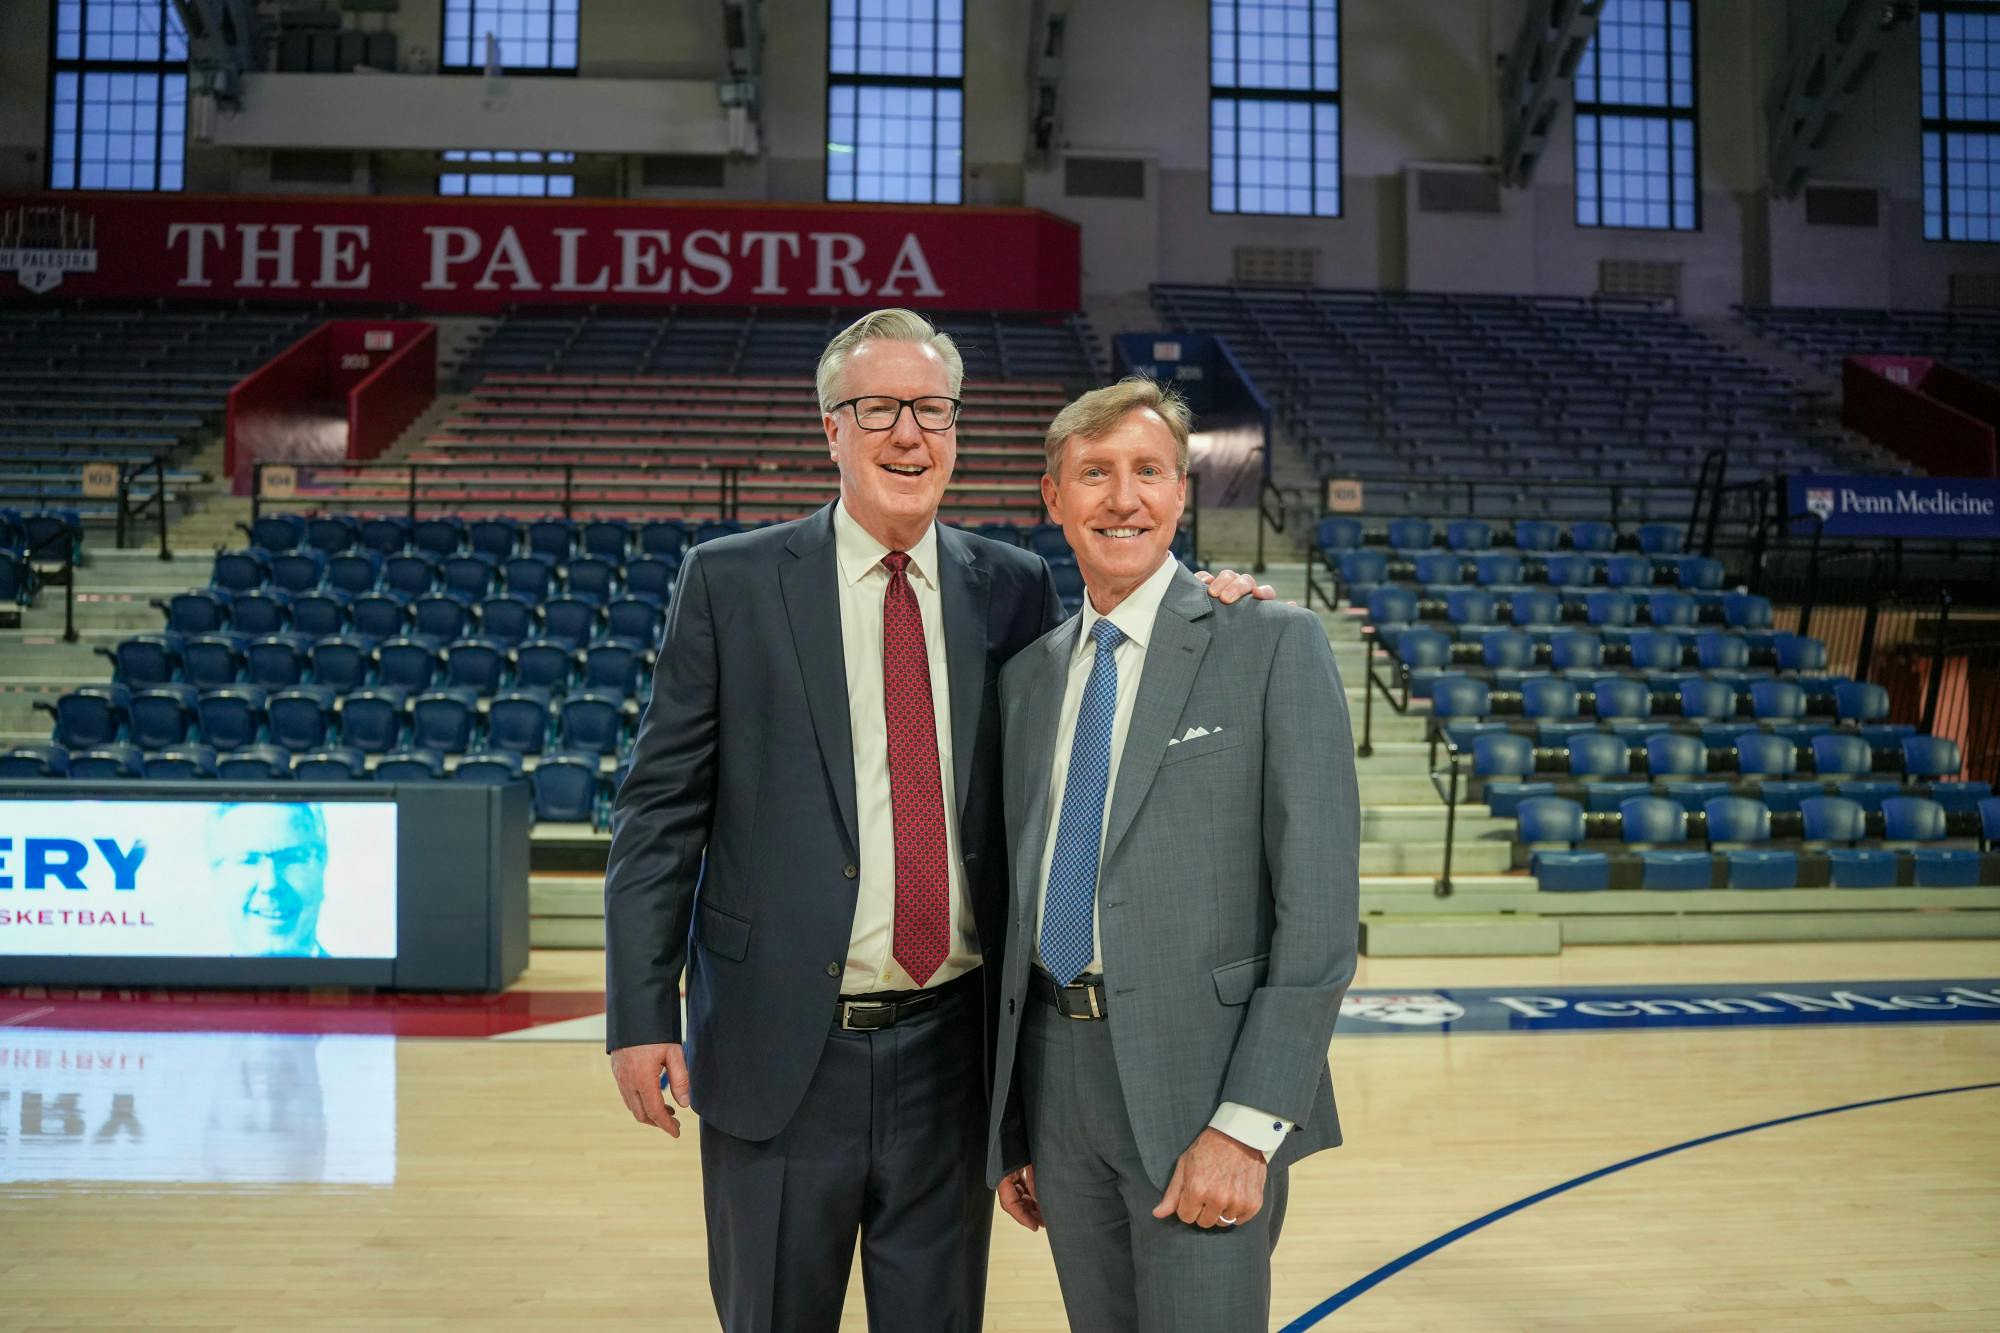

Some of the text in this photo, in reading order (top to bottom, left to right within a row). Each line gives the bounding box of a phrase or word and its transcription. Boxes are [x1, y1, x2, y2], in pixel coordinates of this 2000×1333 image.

[22, 253, 89, 268] PALESTRA
[166, 223, 945, 297] THE PALESTRA
[1840, 488, 1995, 515] Penn Medicine
[0, 838, 147, 890] RY
[1489, 996, 1787, 1018] Penn
